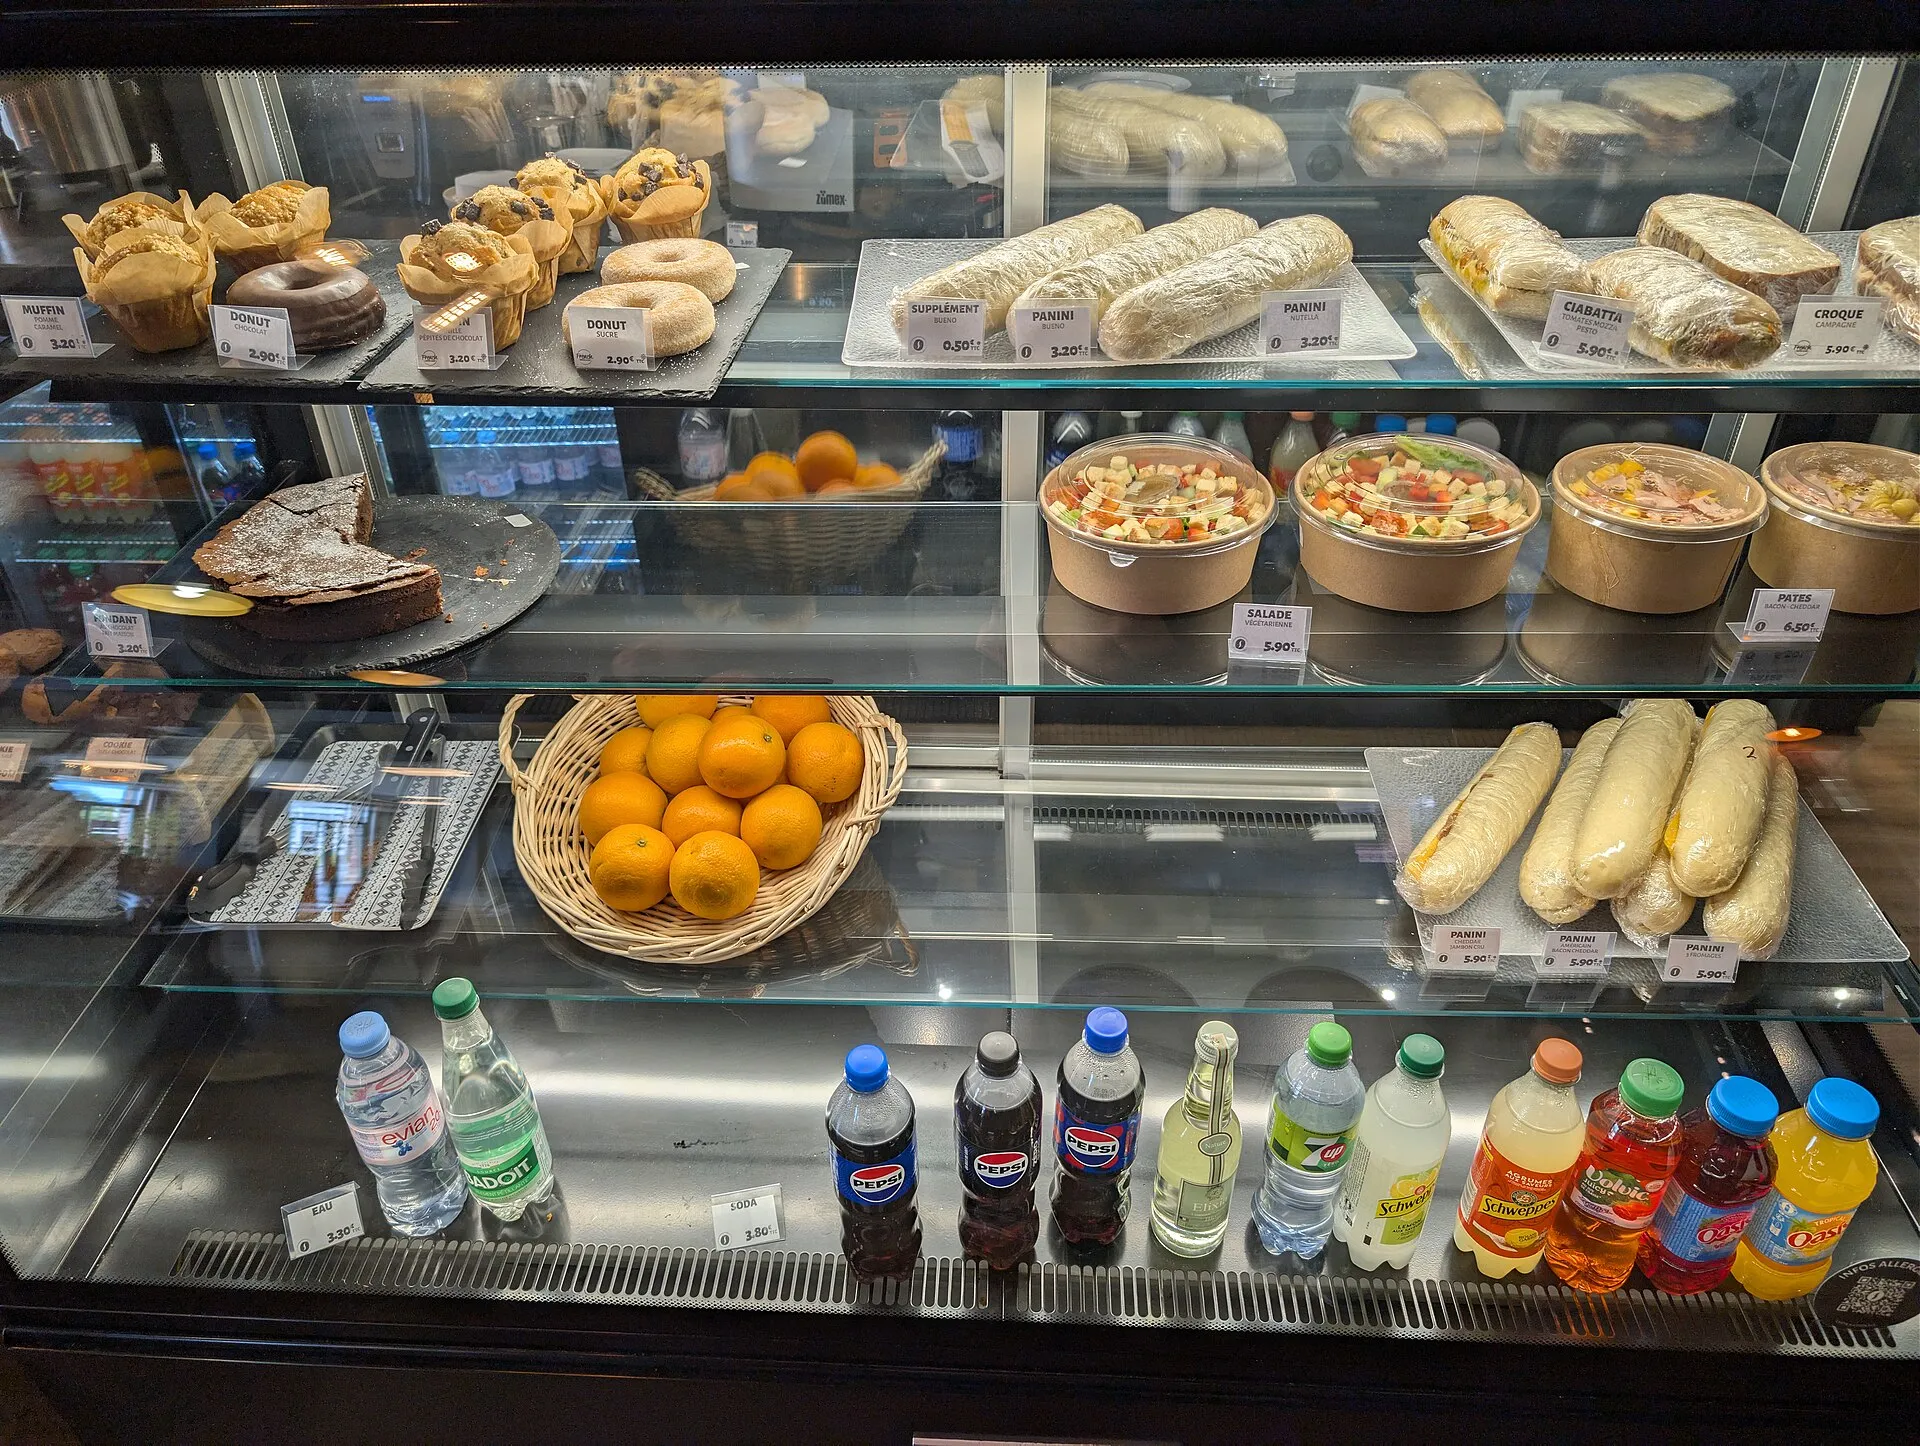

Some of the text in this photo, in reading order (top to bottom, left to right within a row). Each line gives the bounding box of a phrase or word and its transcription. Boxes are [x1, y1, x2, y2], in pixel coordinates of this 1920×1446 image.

[22, 305, 65, 315] MUFFIN
[911, 302, 979, 314] SUPPLÉMENT
[1284, 302, 1326, 313] PANINI
[1563, 301, 1623, 323] CIABATTA
[230, 310, 271, 328] DONUT
[934, 316, 957, 324] BUENO
[1032, 310, 1074, 321] PANINI
[1815, 309, 1864, 321] CROQUE
[587, 320, 627, 330] DONUT
[1562, 313, 1618, 331] TOMATES MOZZA
[234, 324, 267, 336] CHOCOLAT
[1576, 325, 1598, 335] PESTO
[1777, 594, 1812, 603] PATES
[1247, 609, 1292, 620] SALADE
[1244, 619, 1293, 628] VÉGÉTARIENNE
[103, 741, 133, 749] COOKIE
[1742, 745, 1757, 759] 2
[1450, 931, 1486, 939] PANINI
[1559, 935, 1596, 943] PANINI
[1686, 944, 1725, 953] PANINI
[382, 1106, 434, 1145] evian
[1067, 1134, 1117, 1154] PEPSI
[1205, 1140, 1226, 1149] Nature
[977, 1160, 1026, 1175] PEPSI
[853, 1172, 903, 1189] PEPSI
[1507, 1170, 1553, 1185] AGRUMES
[311, 1201, 333, 1216] EAU
[730, 1198, 758, 1211] SODA
[1838, 1262, 1876, 1280] INFOS
